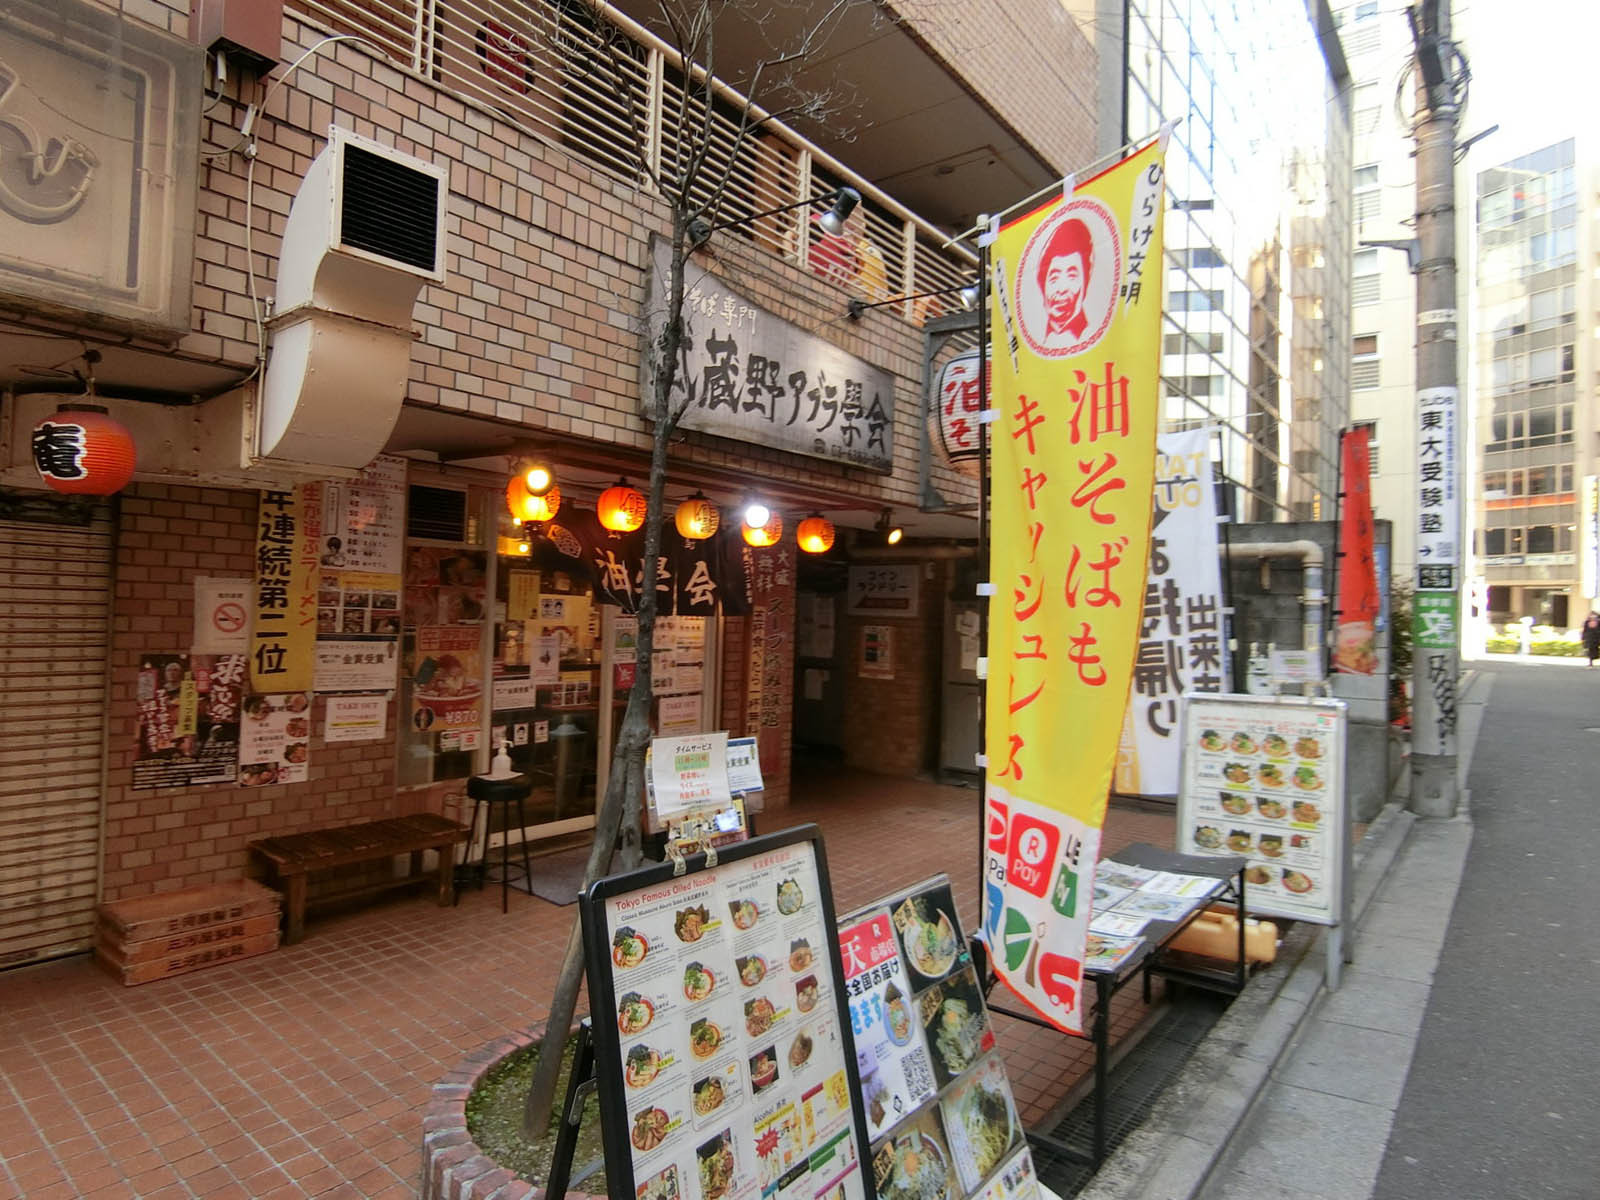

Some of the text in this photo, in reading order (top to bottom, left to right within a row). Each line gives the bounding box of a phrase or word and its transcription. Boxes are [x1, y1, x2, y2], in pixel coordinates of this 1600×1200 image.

[1120, 163, 1163, 304] ひらけ文明
[1419, 410, 1443, 534] 東大受験塾
[1064, 361, 1131, 687] 油そばも
[256, 489, 296, 675] 年連続第二位
[445, 711, 478, 723] ¥870
[676, 743, 712, 753] タイムサービス
[615, 898, 640, 913] Tokyo
[642, 888, 671, 904] Famous
[673, 882, 692, 896] Oiled
[693, 874, 717, 890] Noodle
[1013, 858, 1040, 887] Pay
